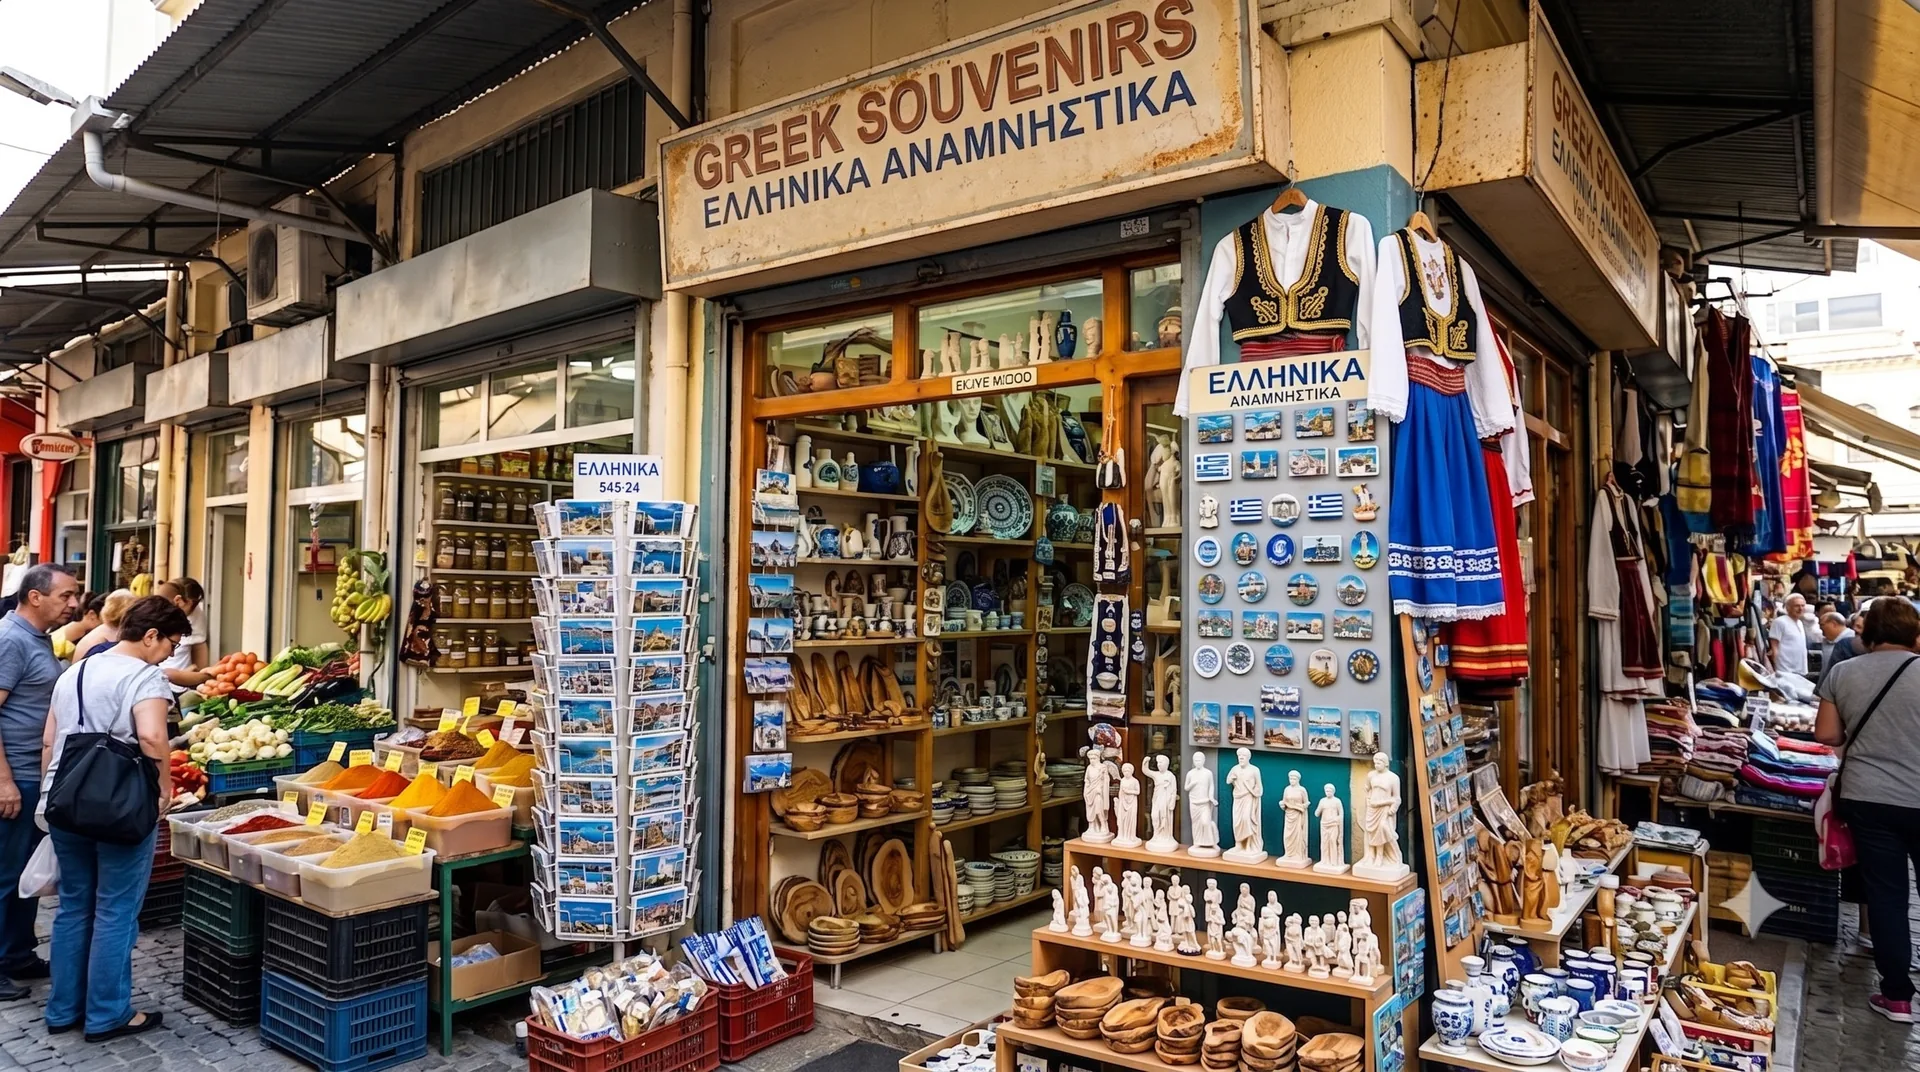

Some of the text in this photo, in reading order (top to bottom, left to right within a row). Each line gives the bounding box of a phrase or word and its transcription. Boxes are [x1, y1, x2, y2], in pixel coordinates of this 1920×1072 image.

[693, 0, 1197, 190] GREEK SOUVENIRS
[1552, 70, 1594, 180] GREEK
[703, 70, 1198, 229] ΕΛΛΗΝΙΚΑ ΑΝΑΜΝΗΣΤΙΚΑ
[1209, 357, 1366, 395] ΕΛΛΗΝΙΚΑ
[1230, 386, 1341, 408] ΑΝΑΜΝΗΣΤΙΚΑ
[578, 462, 659, 476] ΕΛΛΗΝΙΚΑ
